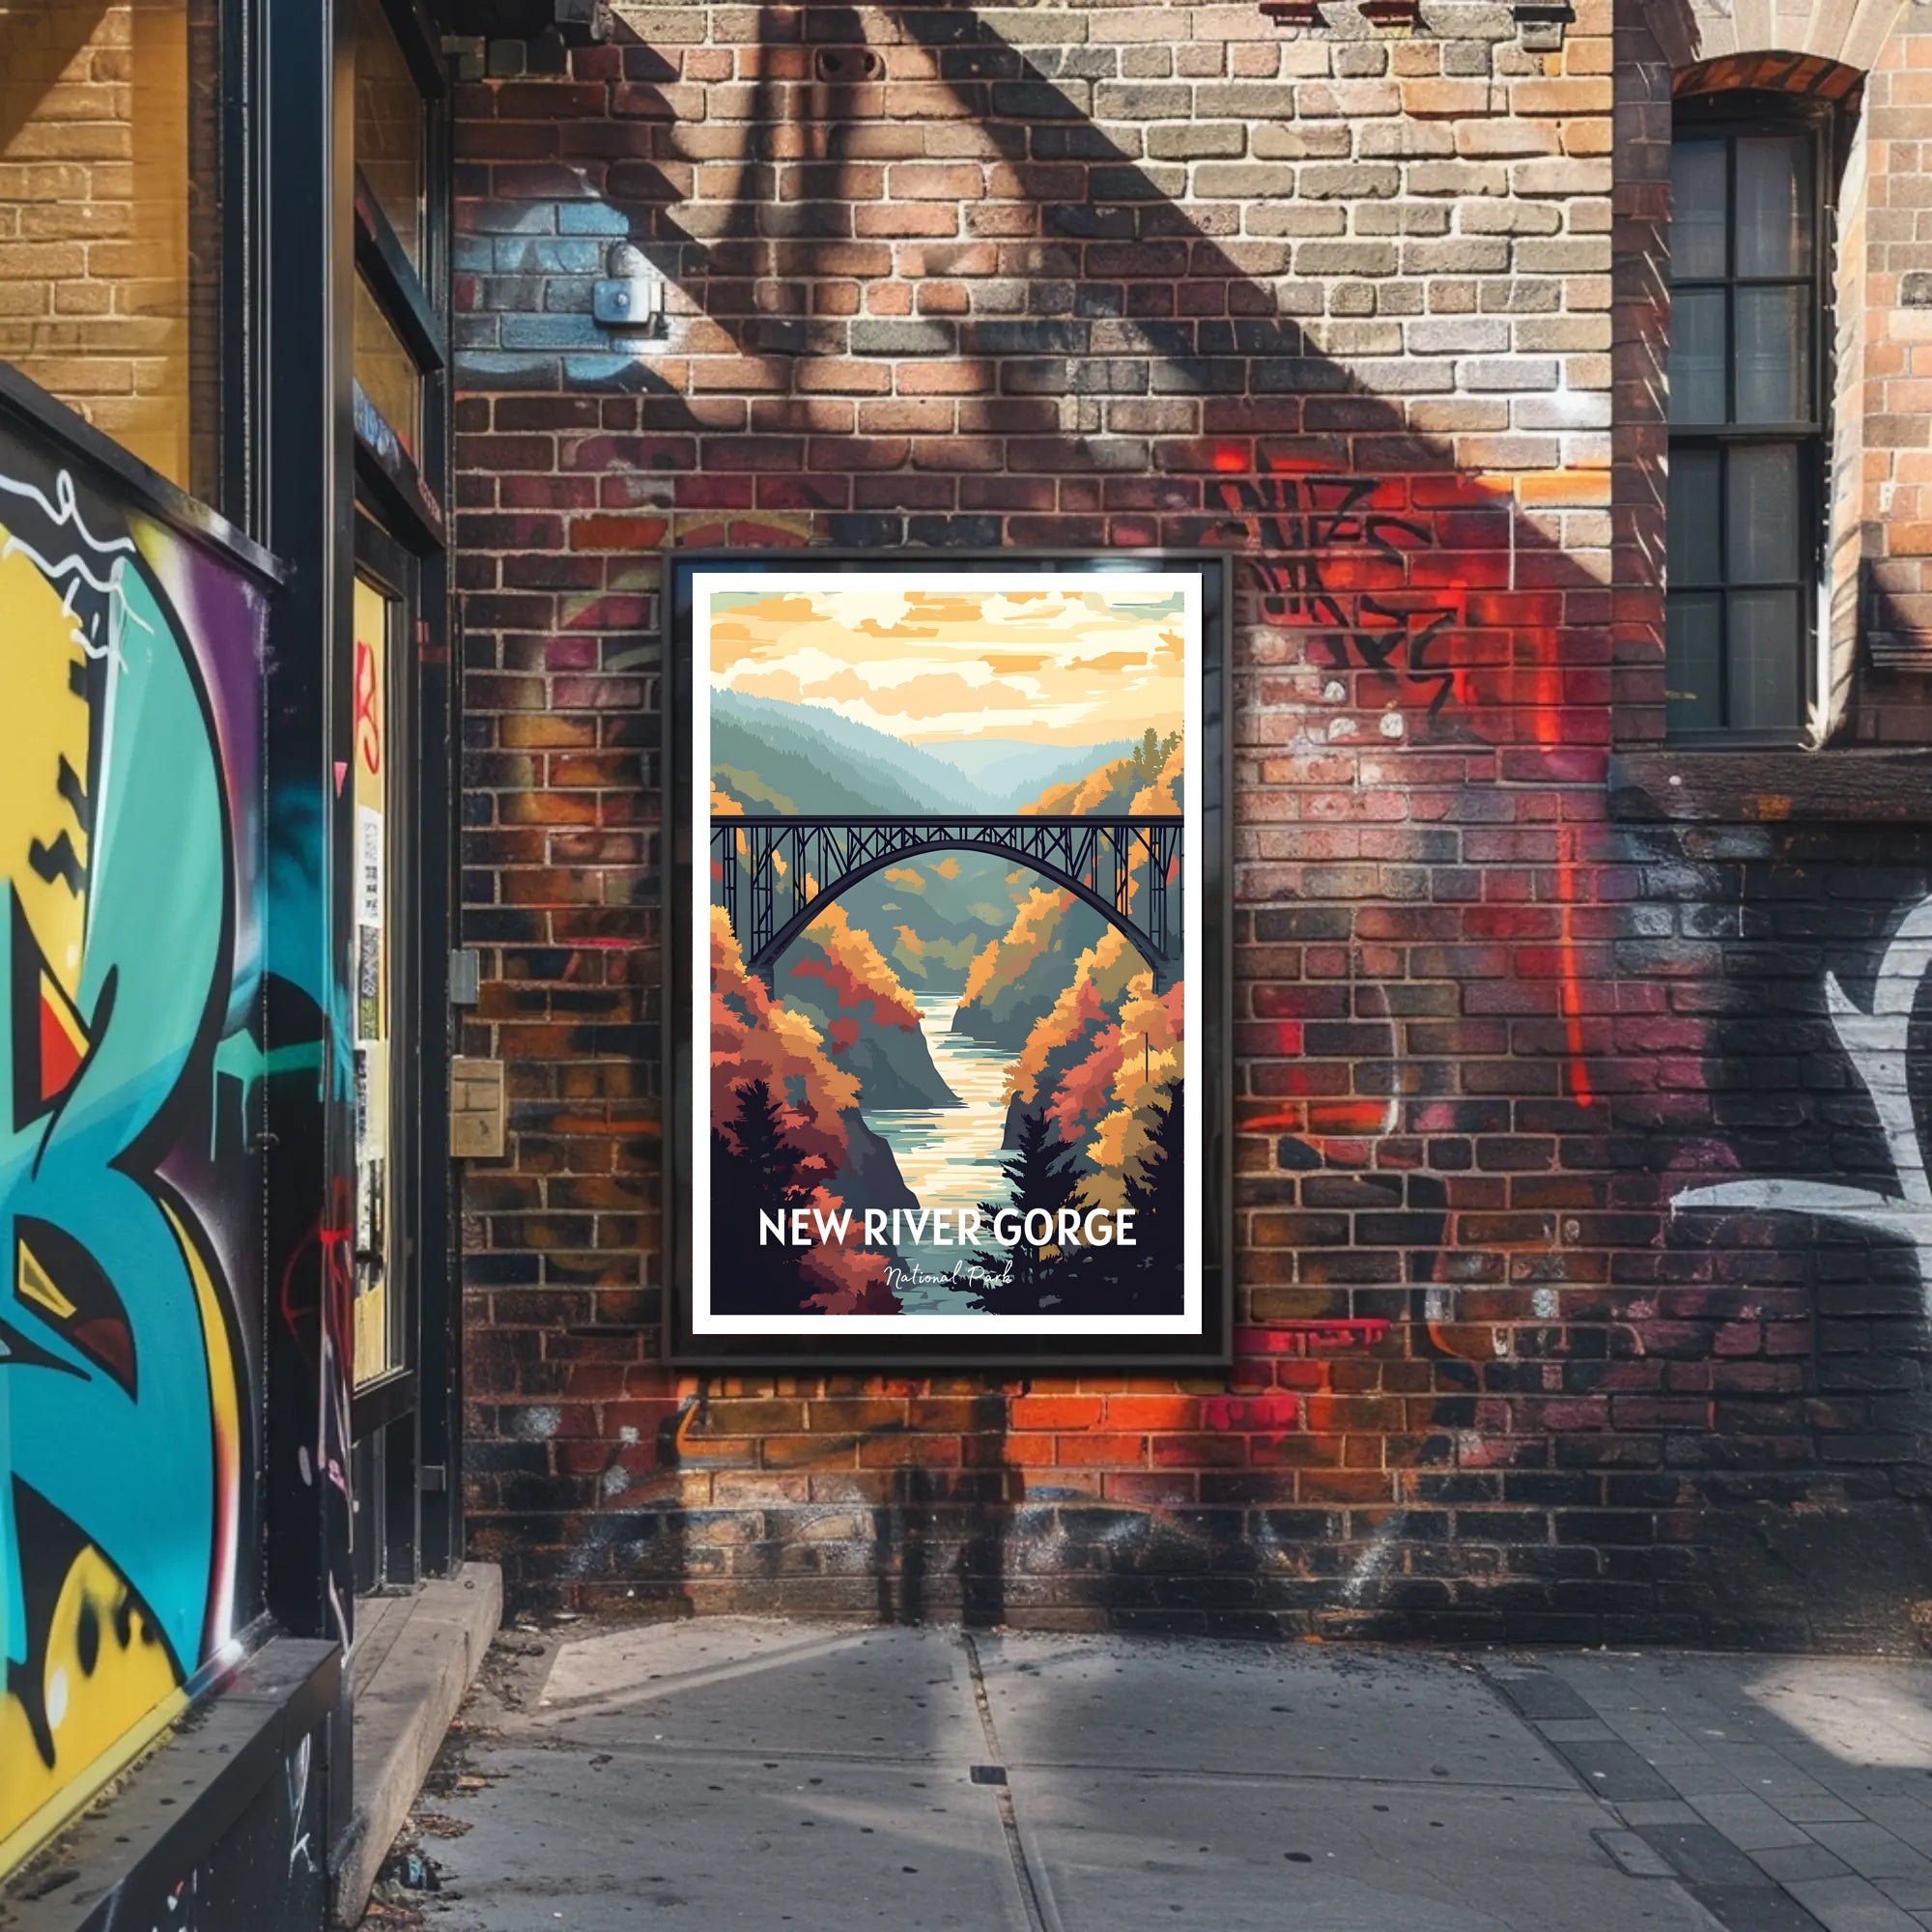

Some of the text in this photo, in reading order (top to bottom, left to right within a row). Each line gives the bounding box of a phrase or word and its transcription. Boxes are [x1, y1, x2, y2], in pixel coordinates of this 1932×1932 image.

[759, 1208, 1137, 1246] NEW RIVER GORGE
[883, 1259, 1012, 1290] National Park
